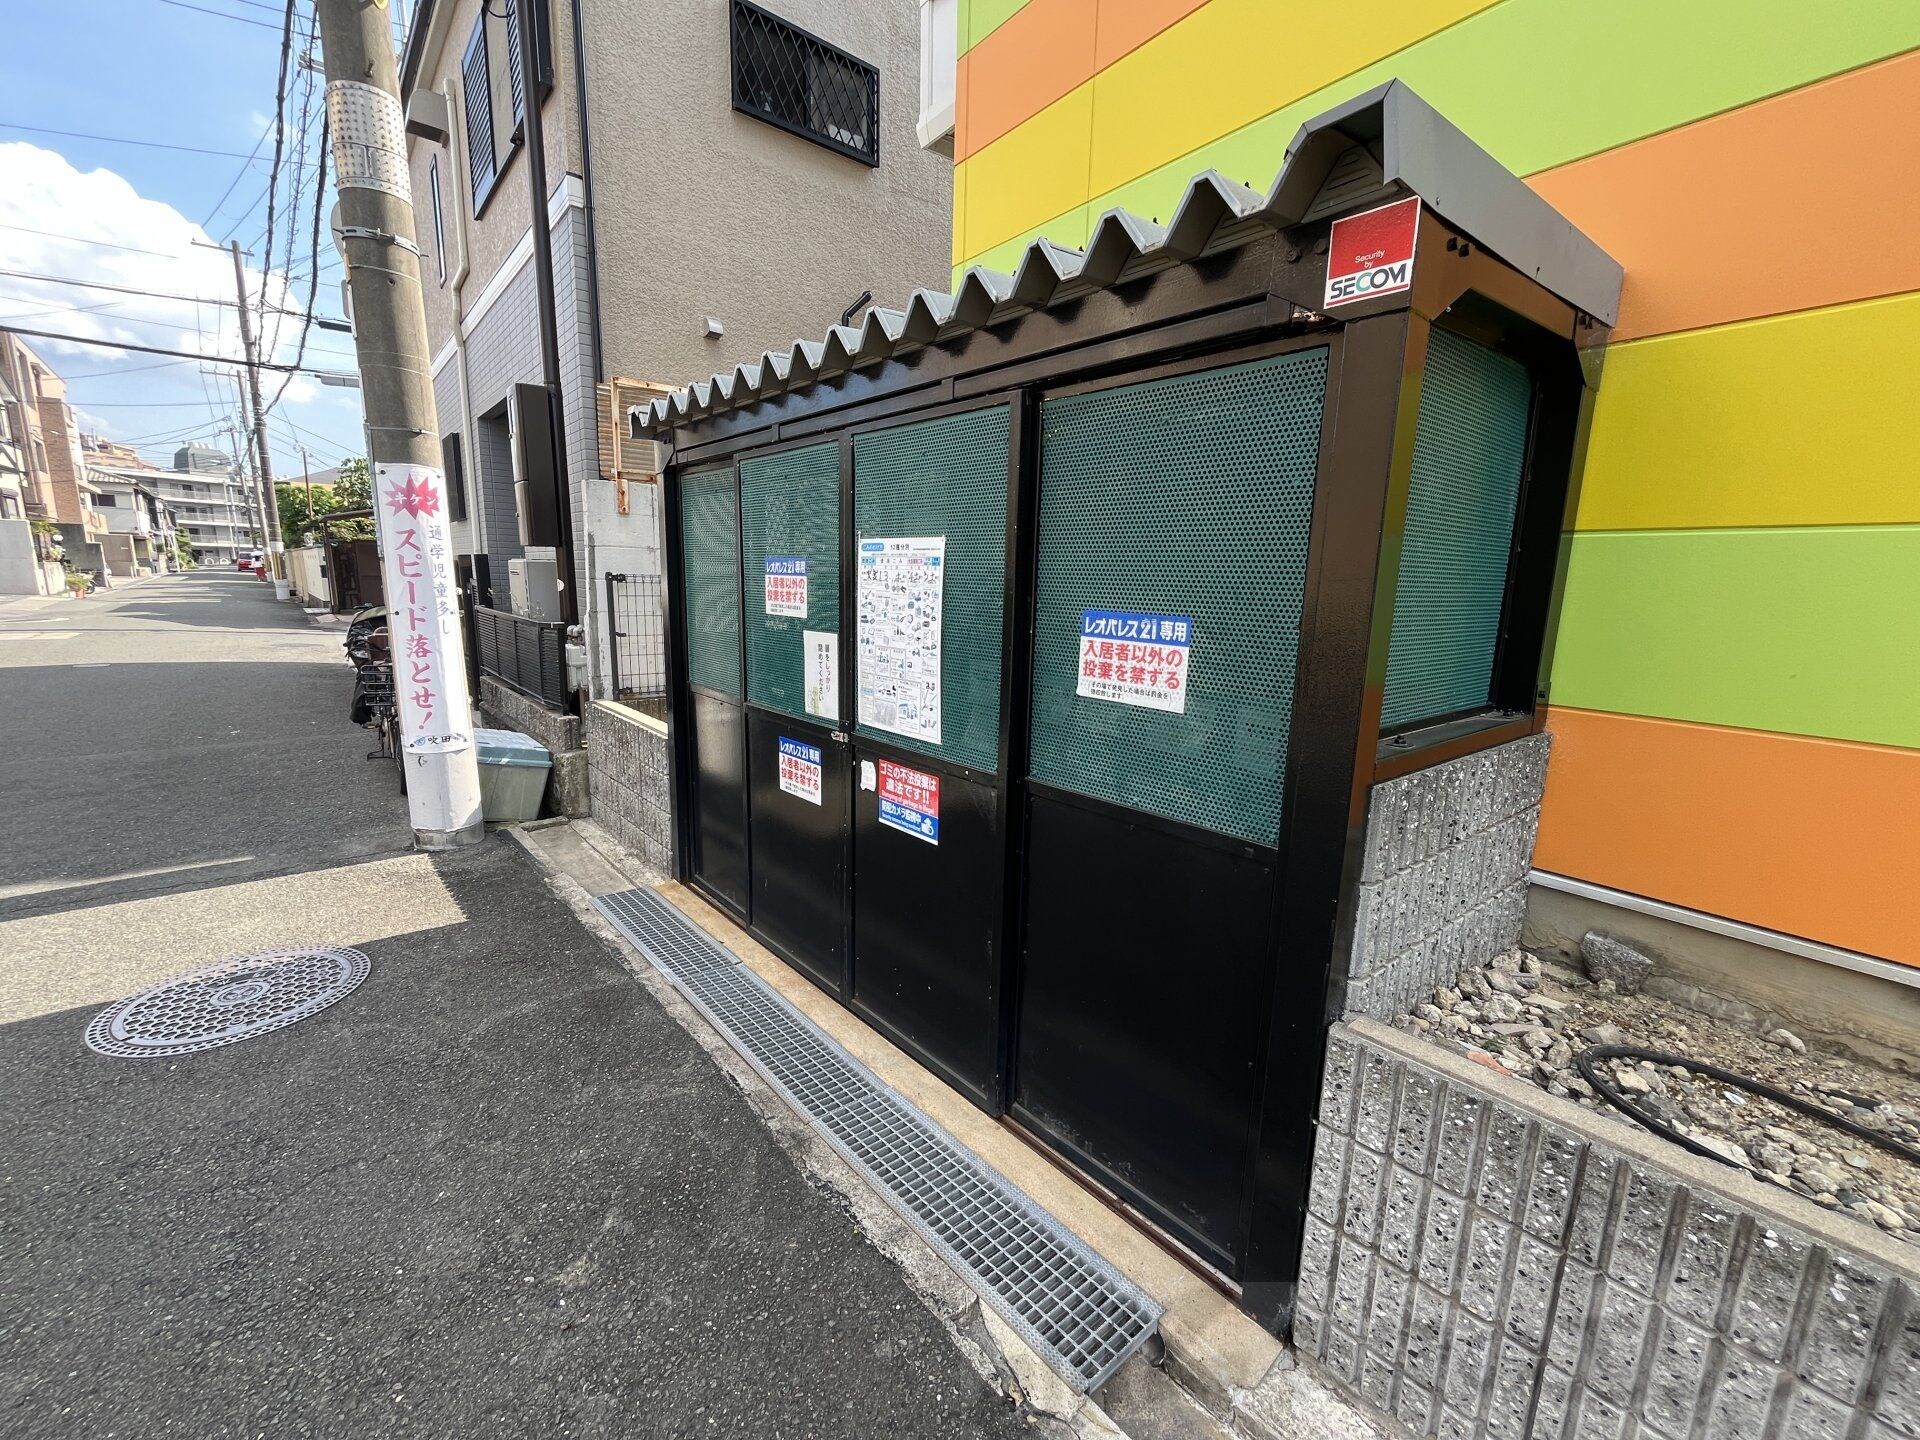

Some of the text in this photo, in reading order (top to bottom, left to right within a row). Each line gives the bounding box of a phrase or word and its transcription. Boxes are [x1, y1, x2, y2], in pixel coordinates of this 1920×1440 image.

[1355, 249, 1386, 263] Security
[1364, 261, 1374, 269] by
[1330, 263, 1407, 300] SECOM
[394, 491, 437, 505] キケン
[428, 524, 451, 636] 通学児童多し
[767, 577, 805, 590] 入居者以外の
[767, 589, 805, 604] 投棄を禁ずる
[393, 527, 437, 731] スピード落とせ!
[1083, 639, 1183, 668] 入居者以外の
[1083, 659, 1181, 690] 投棄を禁ずる
[781, 755, 819, 778] 入居者以外の
[880, 762, 937, 792] ゴミの不法投棄は
[781, 767, 819, 791] 投棄を禁ずる
